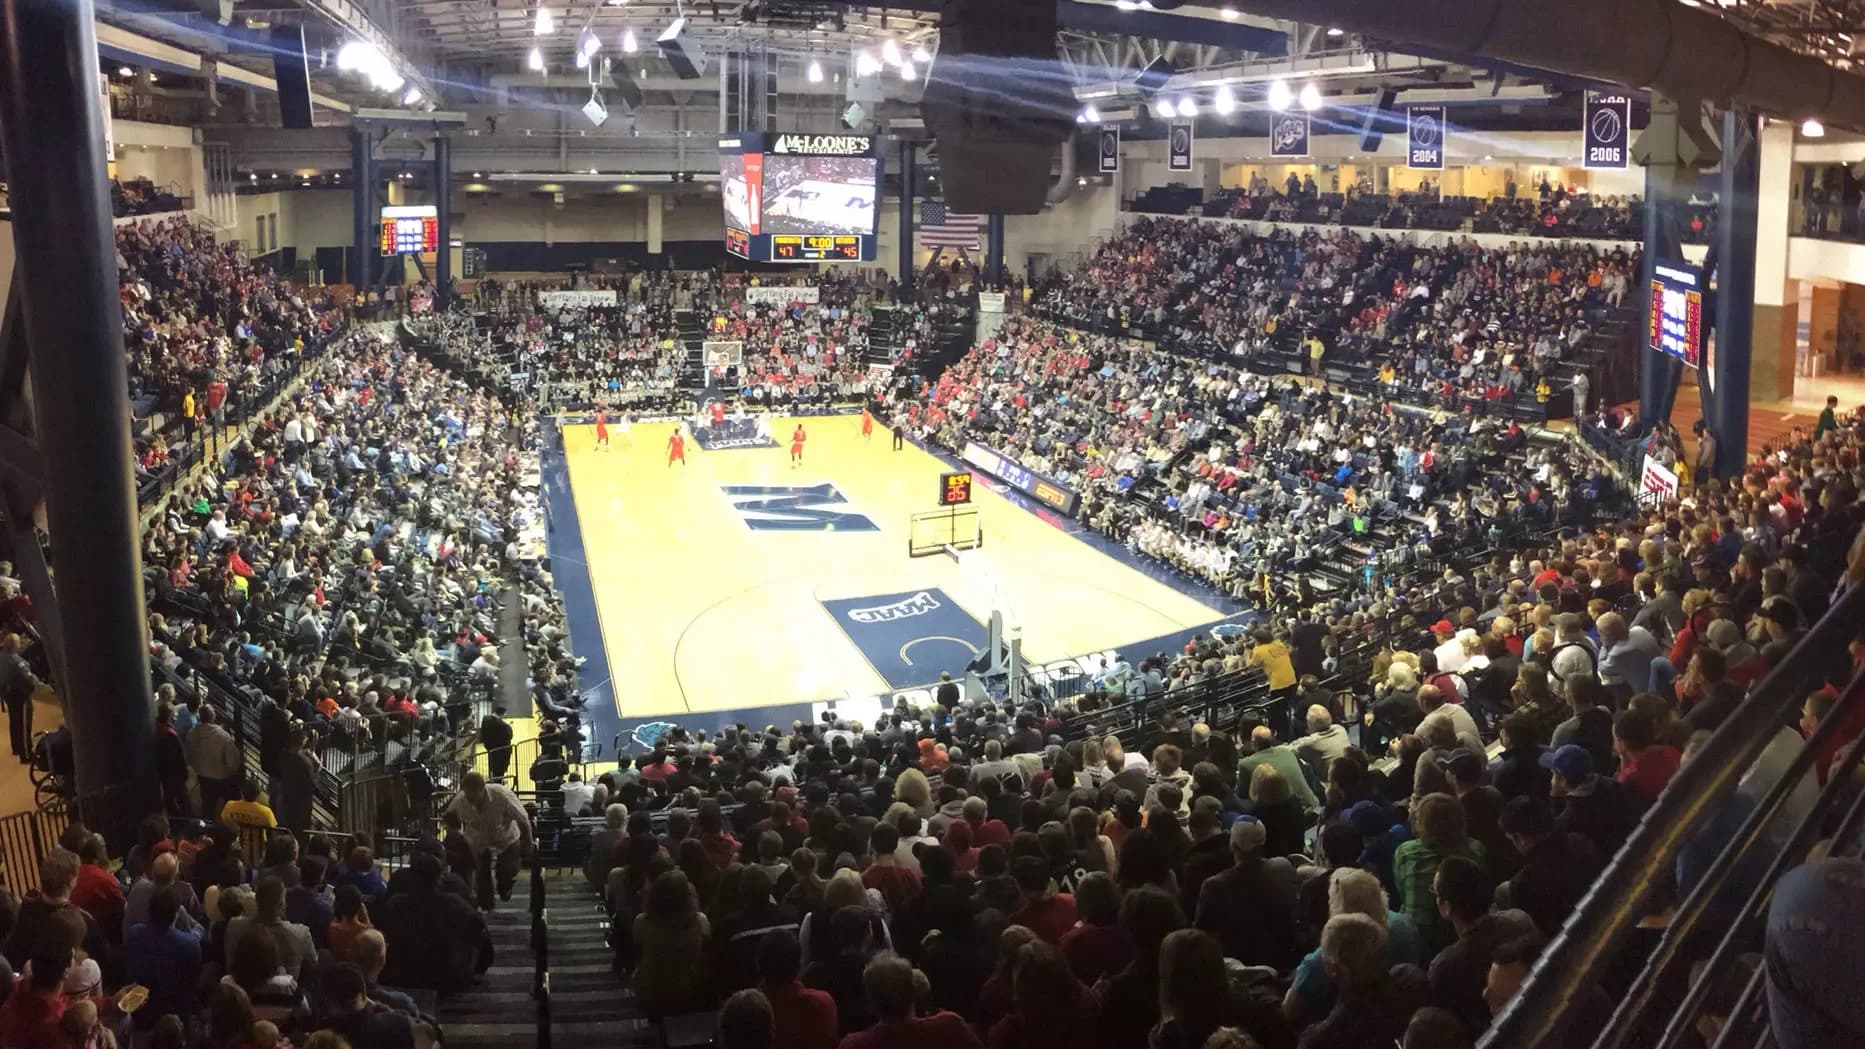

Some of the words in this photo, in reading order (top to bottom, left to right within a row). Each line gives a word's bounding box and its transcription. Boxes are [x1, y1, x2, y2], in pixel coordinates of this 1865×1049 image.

[786, 135, 870, 151] McLOONE'S
[1412, 150, 1437, 162] 2004
[1590, 147, 1621, 161] 2006
[808, 237, 831, 248] 9:00
[779, 246, 793, 256] 47
[844, 247, 857, 257] 45
[850, 592, 940, 622] MAAC
